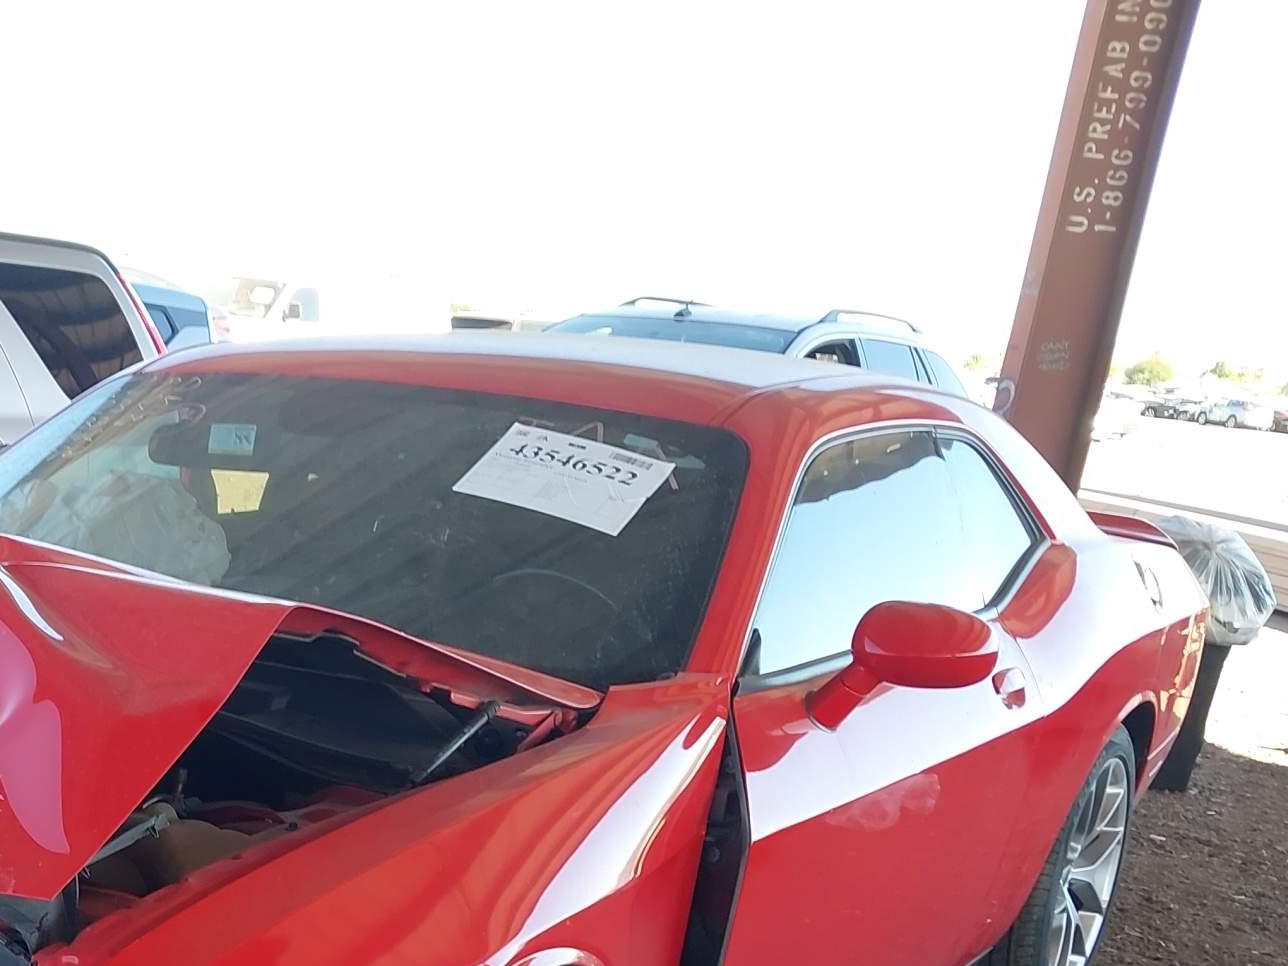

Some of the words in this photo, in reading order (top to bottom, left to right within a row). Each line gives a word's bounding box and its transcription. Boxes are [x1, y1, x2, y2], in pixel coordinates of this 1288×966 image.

[1066, 178, 1099, 233] U.S.
[1083, 40, 1130, 160] PREFAB
[509, 443, 638, 486] 43546522
